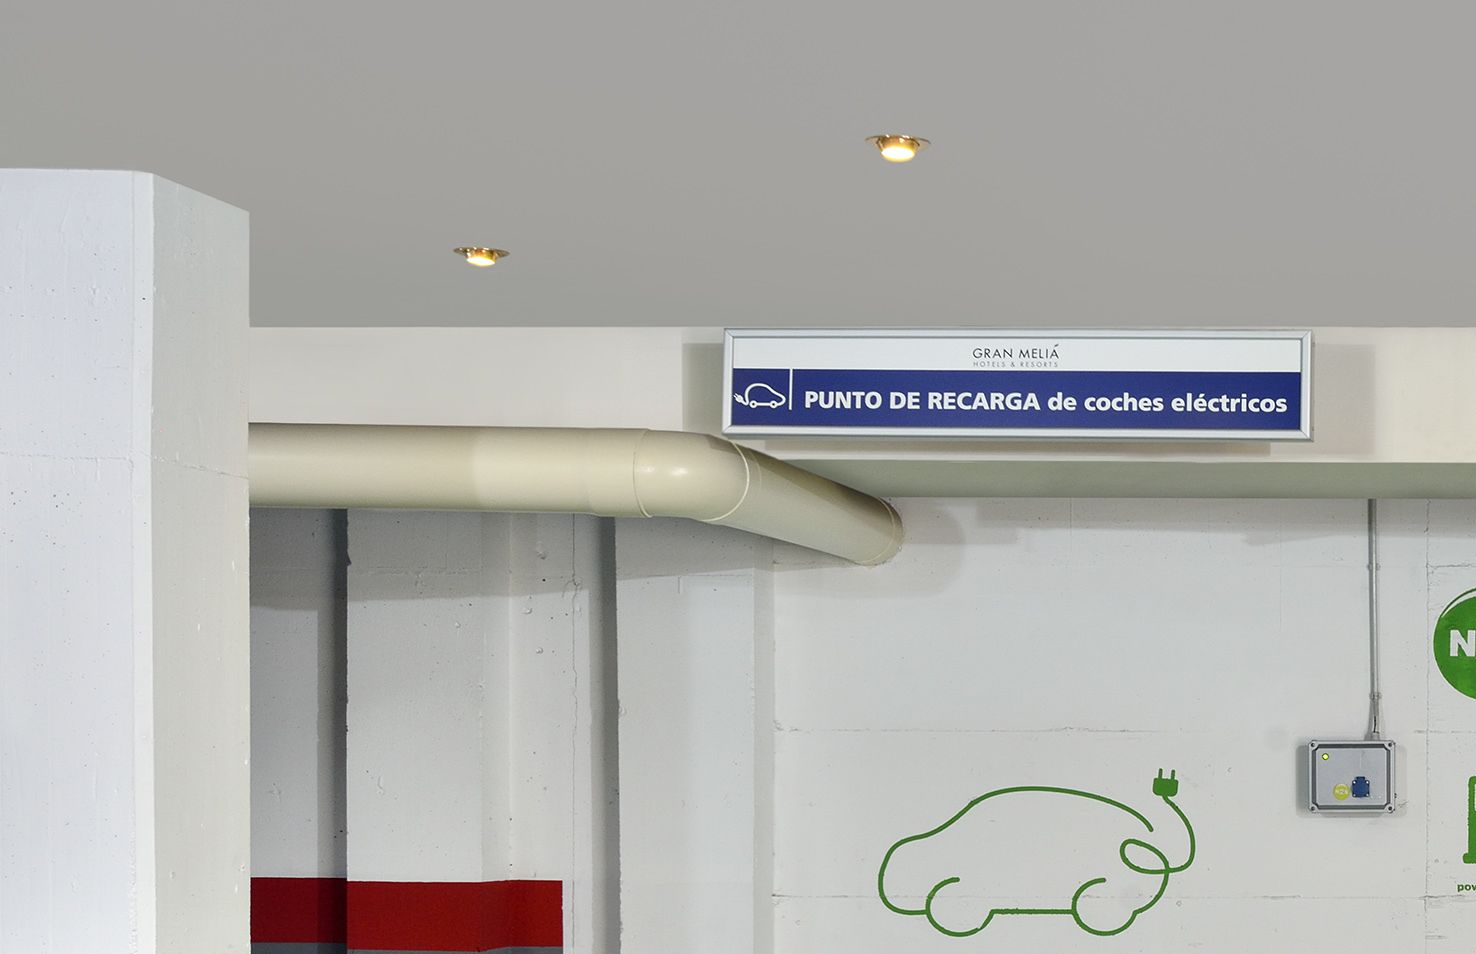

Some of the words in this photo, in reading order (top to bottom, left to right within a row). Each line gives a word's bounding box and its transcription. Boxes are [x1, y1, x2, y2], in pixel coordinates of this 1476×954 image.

[972, 348, 1013, 359] GRAN
[1018, 344, 1059, 359] MELIÁ
[805, 392, 882, 410] PUNTO
[890, 392, 920, 410] DE
[928, 392, 1040, 411] RECARGA
[1047, 392, 1077, 412] de
[1084, 392, 1164, 412] coches
[1170, 392, 1288, 413] eléctricos
